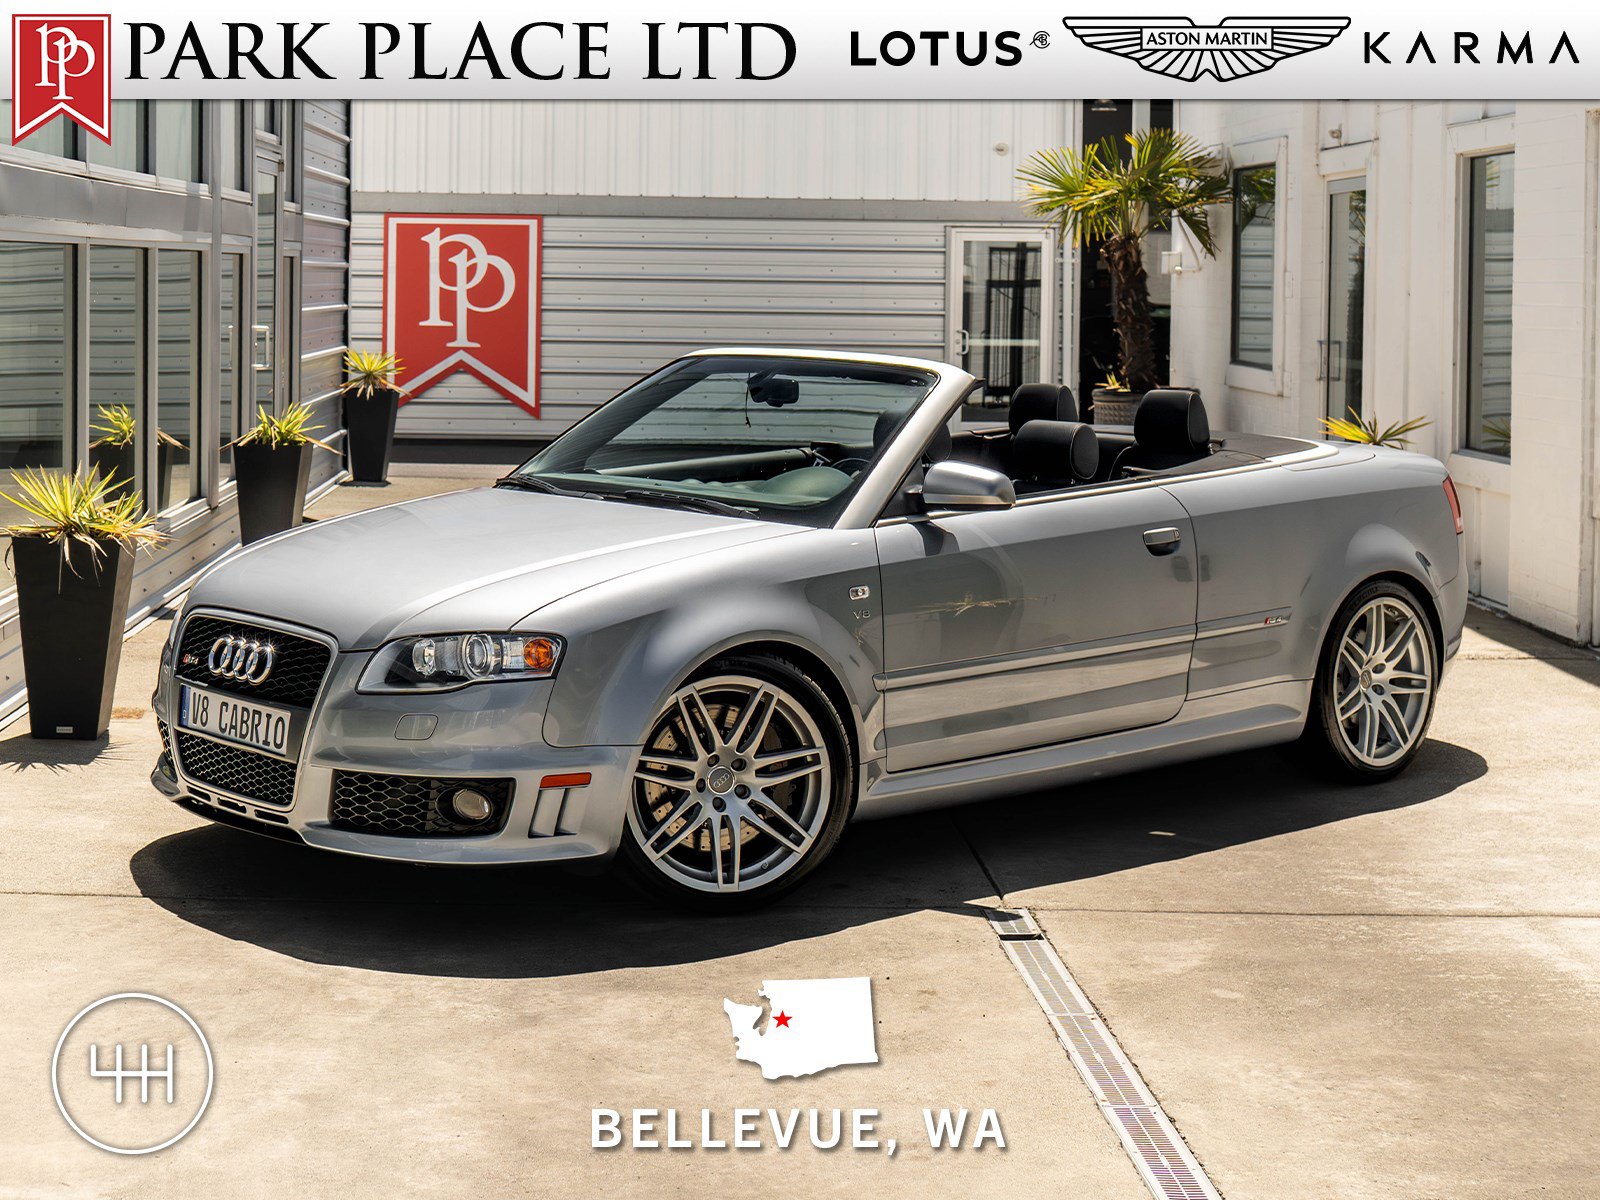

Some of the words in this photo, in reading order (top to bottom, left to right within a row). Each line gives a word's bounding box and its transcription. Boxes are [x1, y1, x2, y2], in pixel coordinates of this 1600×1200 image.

[853, 609, 871, 620] V8
[192, 691, 209, 728] V8
[218, 701, 286, 750] CABRIO
